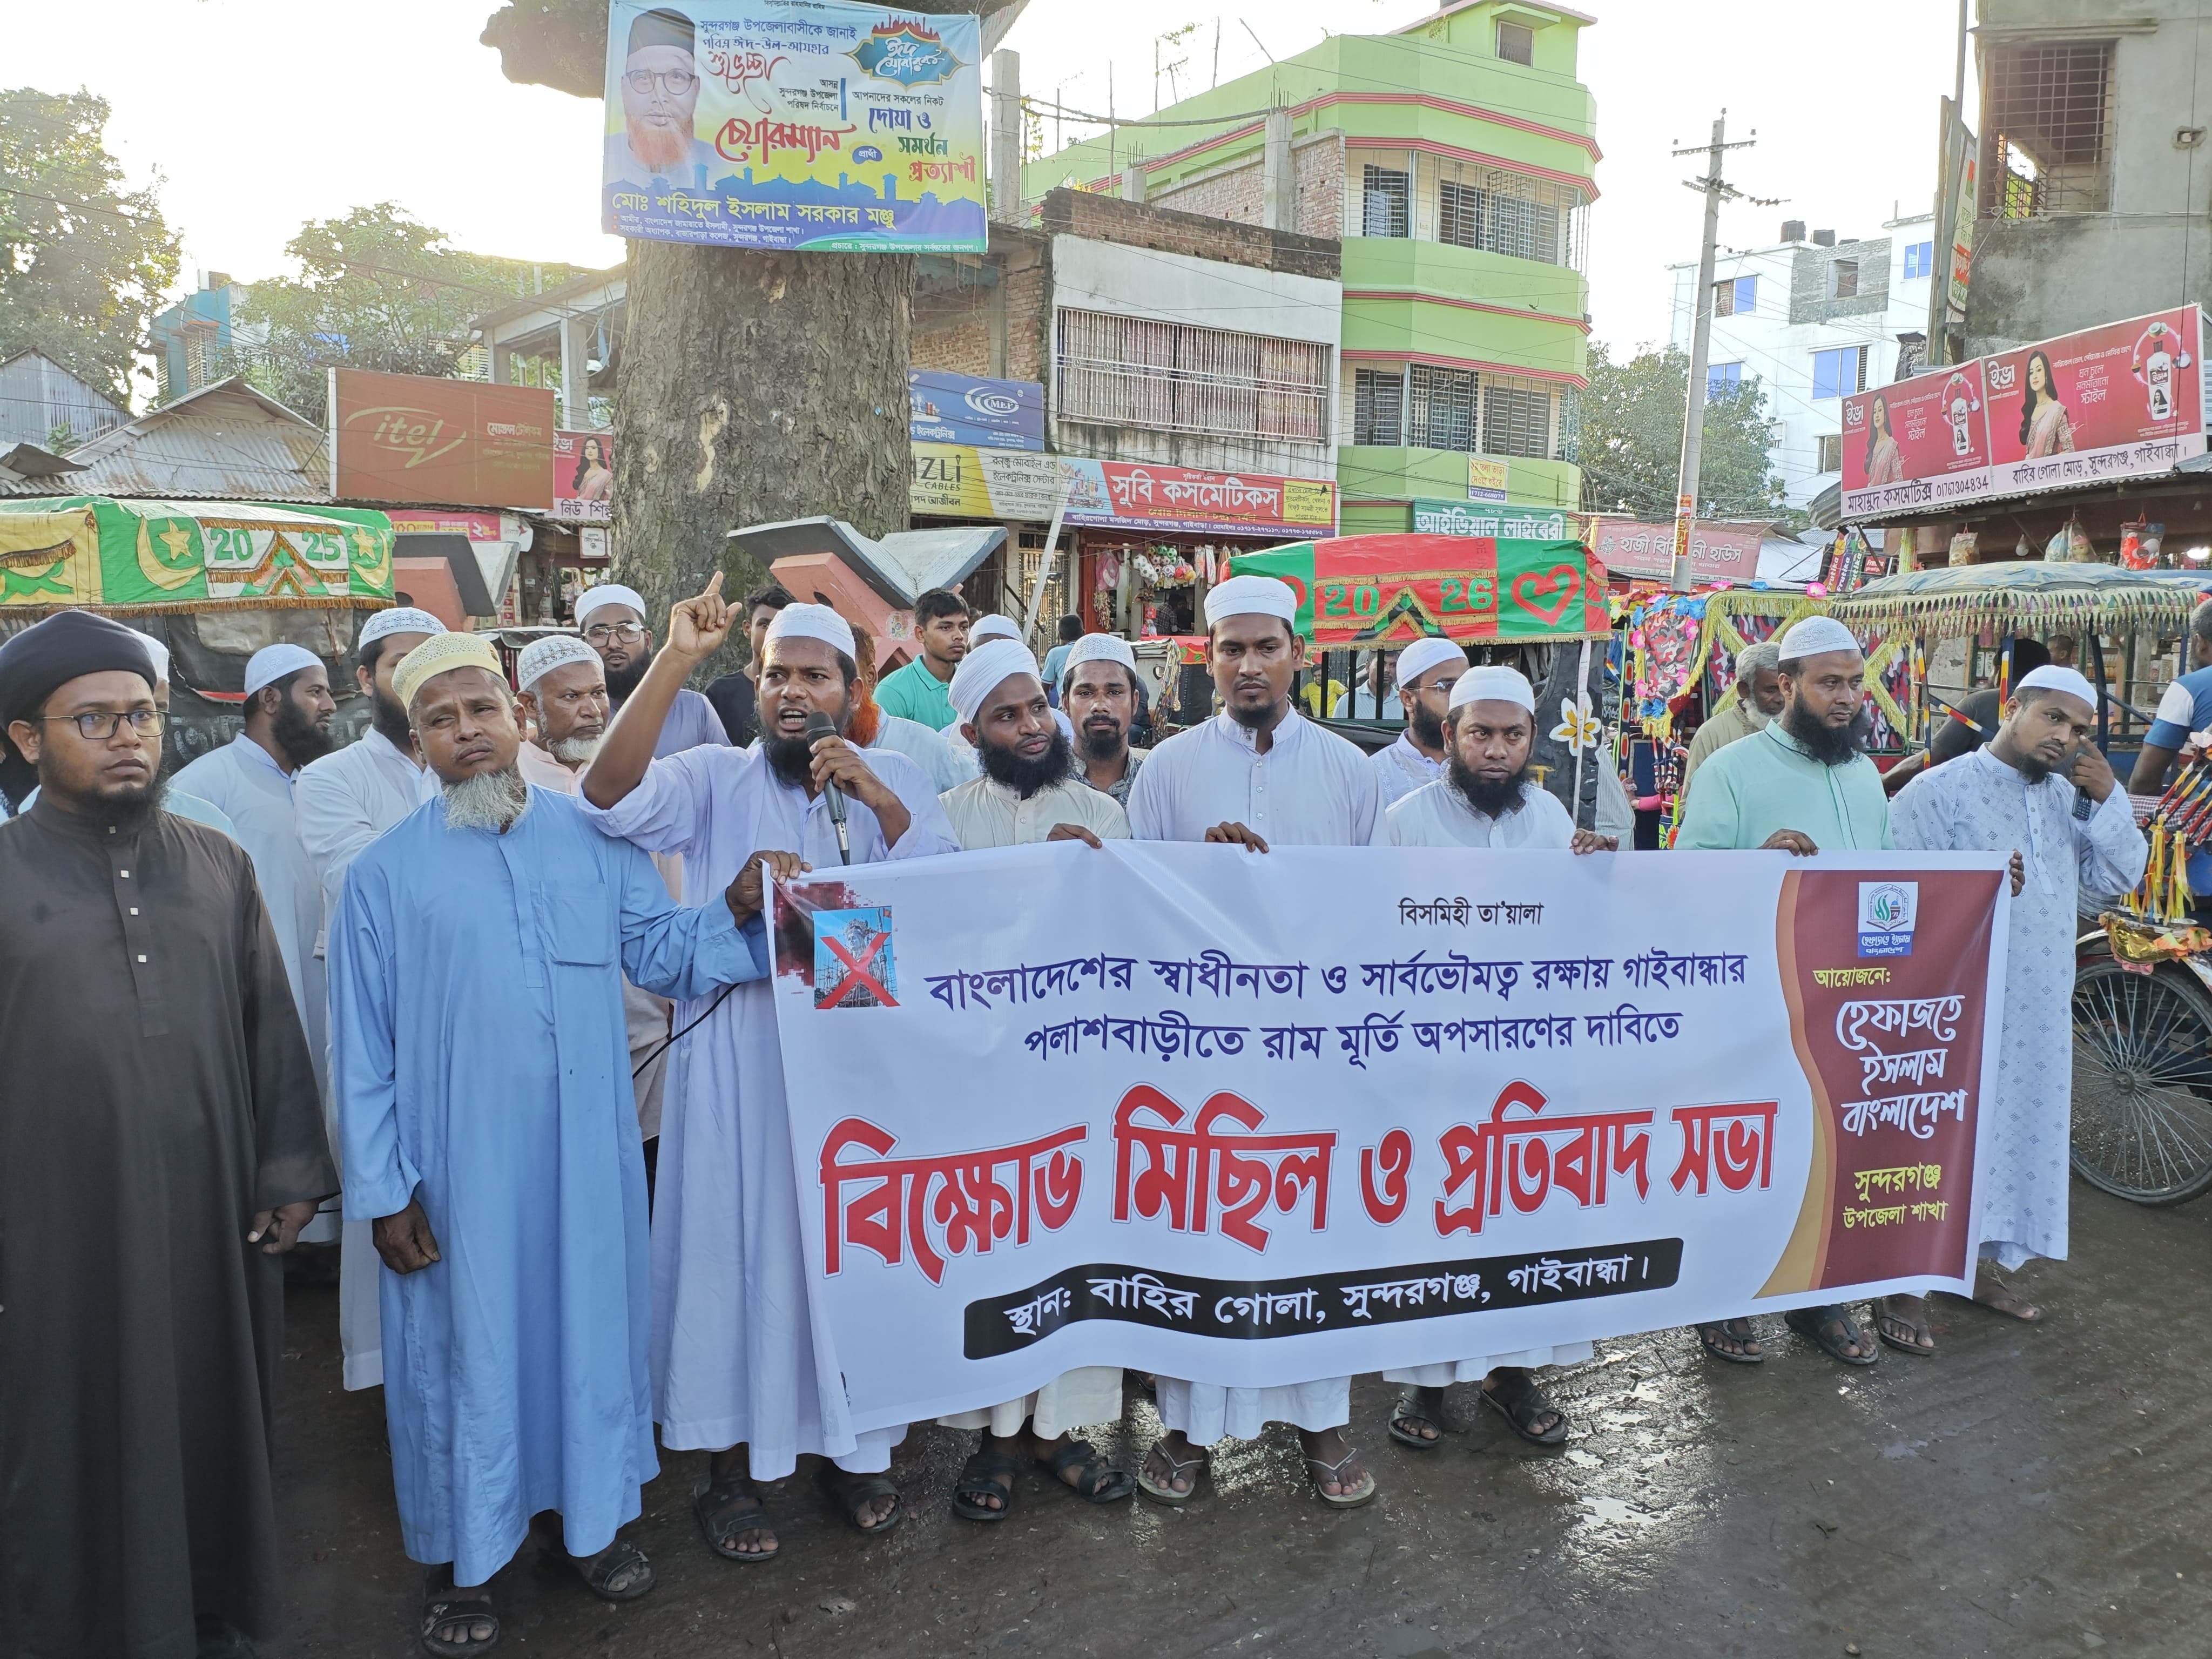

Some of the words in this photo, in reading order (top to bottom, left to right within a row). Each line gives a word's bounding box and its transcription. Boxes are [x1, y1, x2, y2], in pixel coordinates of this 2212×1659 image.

[700, 20, 740, 33] সুন্দরগঞ্জ
[744, 18, 822, 35] উপজেলাবাসীকে
[826, 25, 858, 41] জানাই
[703, 33, 730, 49] পবিত্র
[885, 37, 920, 57] ঈদ
[875, 49, 945, 76] মোবারক
[700, 51, 792, 112] শুভেচ্ছা
[779, 87, 807, 98] সুন্দরগঞ্জ
[810, 88, 838, 100] উপজেলা
[819, 79, 838, 90] আসন্ন
[787, 99, 810, 110] পরিষদ
[812, 100, 838, 112] নির্বাচনে
[852, 91, 891, 103] আপনাদের
[893, 95, 921, 105] সকলের
[924, 95, 944, 106] নিকট
[869, 107, 912, 133] দোয়া
[916, 112, 931, 129] ও
[898, 132, 948, 157] সমর্থন
[908, 152, 976, 184] প্রত্যাশী
[612, 193, 649, 212] মোঃ
[655, 192, 721, 220] শহিদুল
[725, 195, 792, 221] ইসলাম
[795, 204, 861, 225] সরকার
[865, 207, 896, 231] মঞ্জু
[621, 224, 643, 234] সহকারী
[644, 216, 673, 227] বাংলাদেশ
[732, 224, 757, 233] সুন্দরগঞ্জ
[759, 224, 785, 234] উপজেলা
[859, 243, 887, 252] সুন্দরগঞ্জ
[1988, 360, 2015, 389] ইভা
[2075, 376, 2109, 390] মনমাতানো
[2079, 367, 2089, 378] ঘন
[2089, 365, 2104, 379] চুলে
[2081, 389, 2107, 404] স্টাইল
[1846, 400, 1864, 426] ইভা
[1905, 417, 1927, 429] মনমাতানো
[1907, 409, 1914, 418] ঘন
[1914, 407, 1924, 419] চুলে
[374, 414, 443, 444] itel
[1908, 428, 1926, 441] স্টাইল
[1013, 457, 1042, 468] মোবাইল
[1480, 463, 1491, 471] তলা
[2013, 464, 2035, 484] বাহির
[2038, 463, 2060, 480] গোলা
[924, 481, 961, 491] CABLES
[1033, 474, 1055, 484] সেন্টার
[928, 493, 961, 507] আজীবন
[1109, 469, 1156, 509] সুবি
[1160, 476, 1281, 517] কসমেটিকস্
[1847, 491, 1880, 512] মাহামুদ
[1884, 478, 1932, 505] কসমেটিক্স
[561, 499, 584, 516] নিউ
[1072, 514, 1107, 523] বাহিরগোলা
[1109, 516, 1132, 525] মসজিদ
[1415, 506, 1499, 537] আইডিয়াল
[211, 529, 254, 561] 20
[302, 529, 341, 563] 25
[1620, 533, 1650, 554] হাজী
[1710, 543, 1743, 563] হাউস
[1826, 557, 1839, 591] Frutika
[1836, 557, 1851, 592] Frutika
[1848, 552, 1863, 592] Frutika
[1324, 584, 1380, 617] 20
[1440, 577, 1494, 612] 26
[1398, 896, 1473, 928] বিসমিহী
[924, 952, 1139, 1011] বাংলাদেশের
[1148, 949, 1309, 1000] স্বাধীনতা
[1321, 967, 1347, 994] ও
[1360, 950, 1523, 1001] সার্বভৌমত্ব
[1530, 955, 1615, 991] রক্ষায়
[1623, 946, 1748, 990] গাইবান্ধার
[1836, 995, 1965, 1050] হেফাজতে
[1024, 1010, 1249, 1062] পলাশবাড়ীতে
[1262, 1022, 1327, 1061] রাম
[1336, 1010, 1405, 1070] মূর্তি
[1411, 1013, 1577, 1055] অপসারণের
[1586, 1003, 1684, 1046] দাবিতে
[1859, 1042, 1948, 1096] ইসলাম
[1841, 1089, 1968, 1139] বাংলাদেশ
[818, 1115, 1089, 1286] বিক্ষোভ
[1111, 1081, 1339, 1255] মিছিল
[1359, 1127, 1414, 1226] ও
[1433, 1078, 1656, 1238] প্রতিবাদ
[1668, 1098, 1781, 1197] সভা
[1854, 1161, 1942, 1203] সুন্দরগঞ্জ
[1842, 1203, 1907, 1229] উপজেলা
[1910, 1200, 1948, 1222] শাখা
[1086, 1272, 1199, 1319] বাহির
[1214, 1289, 1326, 1325] গোলা,
[1340, 1272, 1491, 1319] সুন্দরগঞ্জ,
